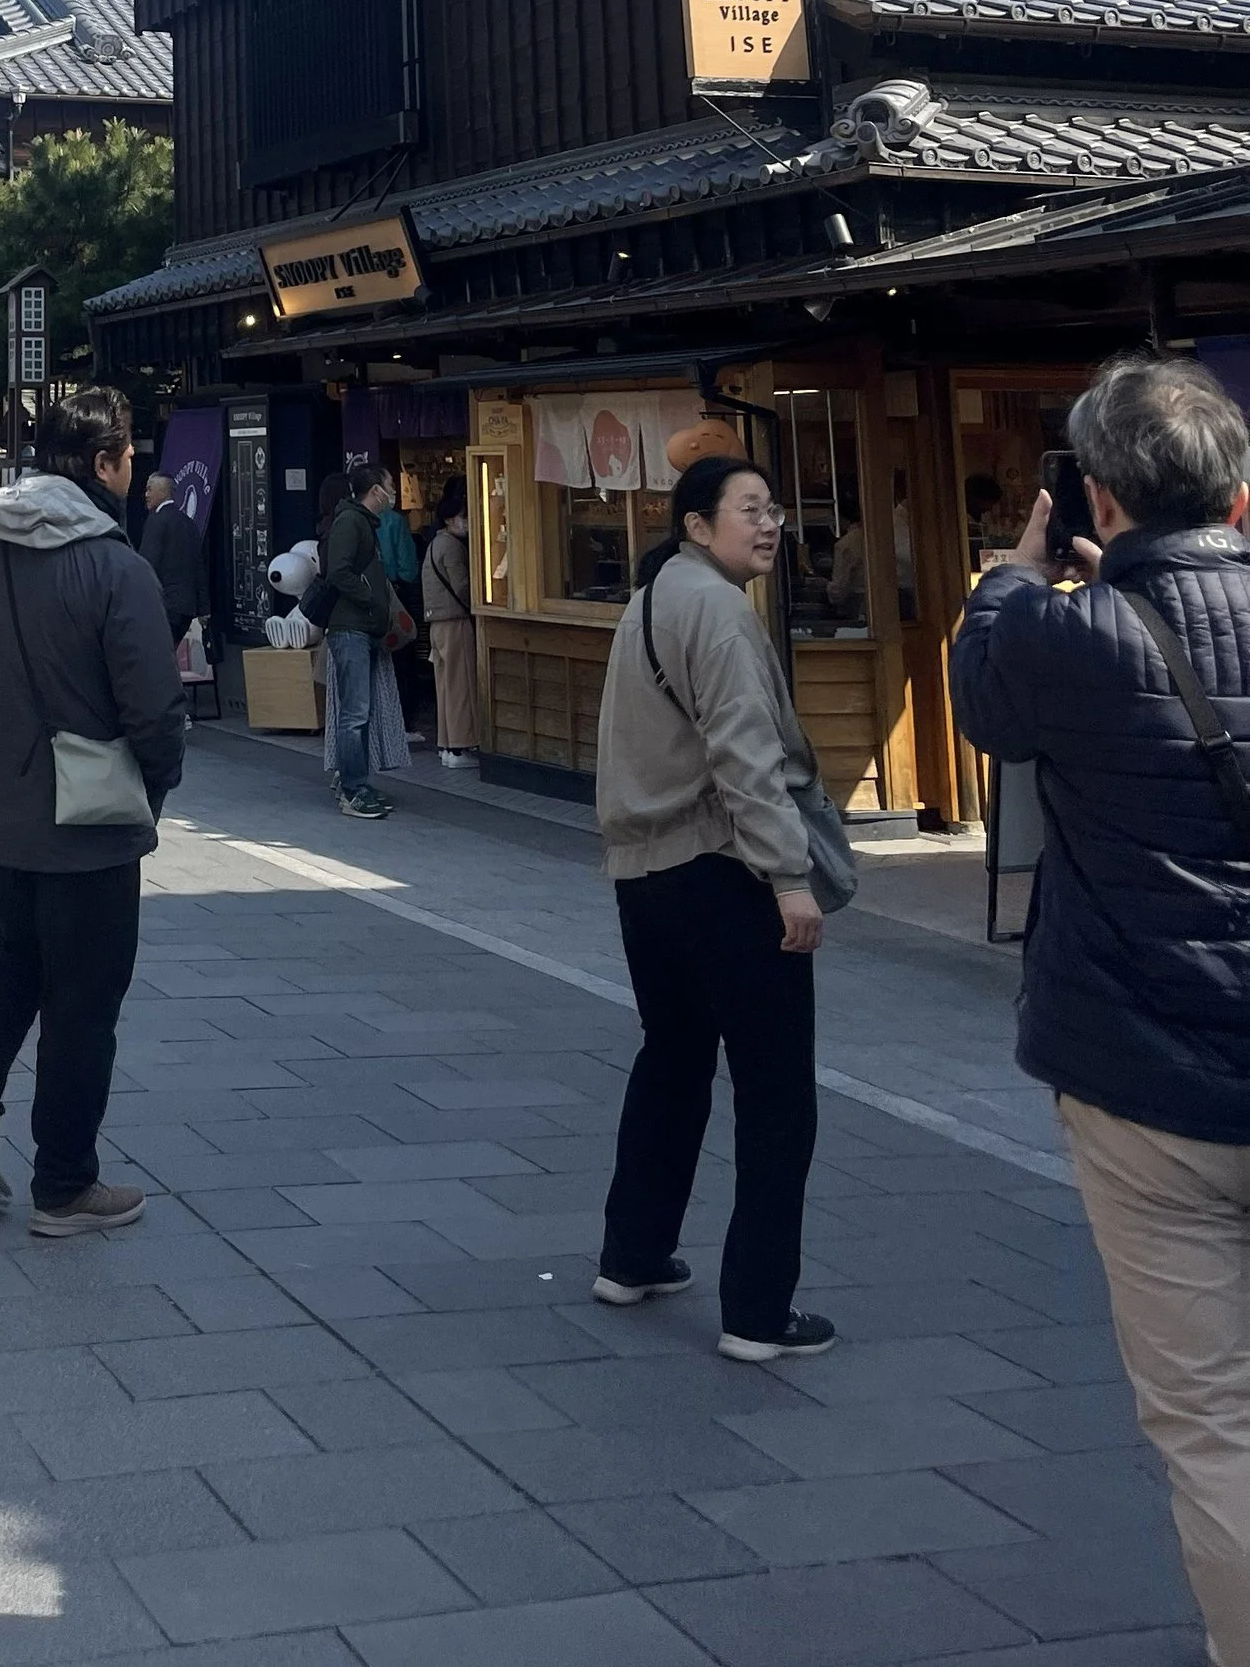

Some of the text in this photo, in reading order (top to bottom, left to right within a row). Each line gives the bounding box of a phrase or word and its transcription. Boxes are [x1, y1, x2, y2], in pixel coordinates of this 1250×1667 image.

[719, 5, 779, 26] Village
[730, 35, 774, 54] ISE
[273, 244, 407, 289] SNOOPY Village
